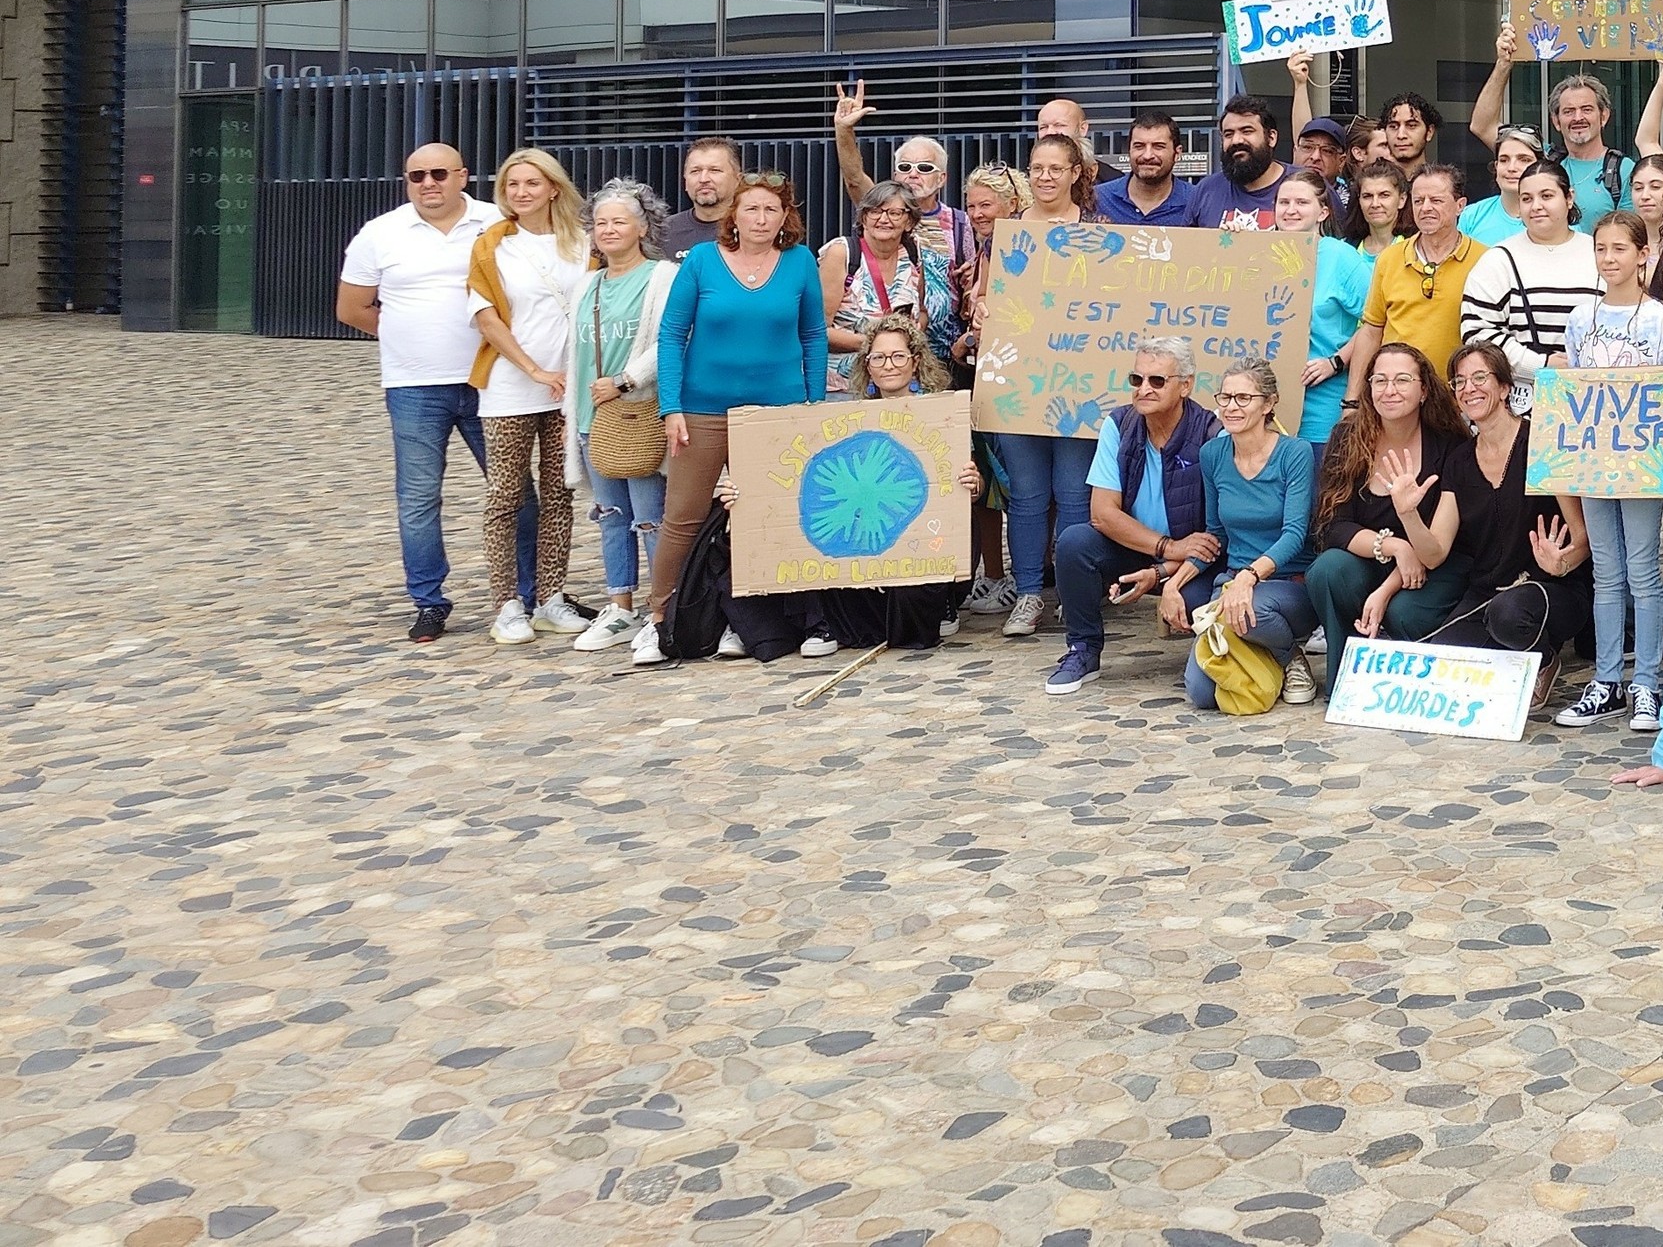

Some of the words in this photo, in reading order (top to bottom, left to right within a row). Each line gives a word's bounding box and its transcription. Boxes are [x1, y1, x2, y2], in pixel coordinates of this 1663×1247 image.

[1041, 247, 1088, 289] LA
[1066, 301, 1122, 323] EST
[1145, 302, 1232, 329] JUSTE
[1047, 332, 1091, 354] UNE
[1203, 331, 1284, 361] CASSÉ
[1050, 362, 1094, 394] PAS
[767, 434, 812, 490] LSF
[821, 410, 866, 441] EST
[879, 409, 913, 433] UNE
[1556, 422, 1597, 452] LA
[776, 559, 842, 584] NON
[1362, 680, 1485, 728] SOURDES
